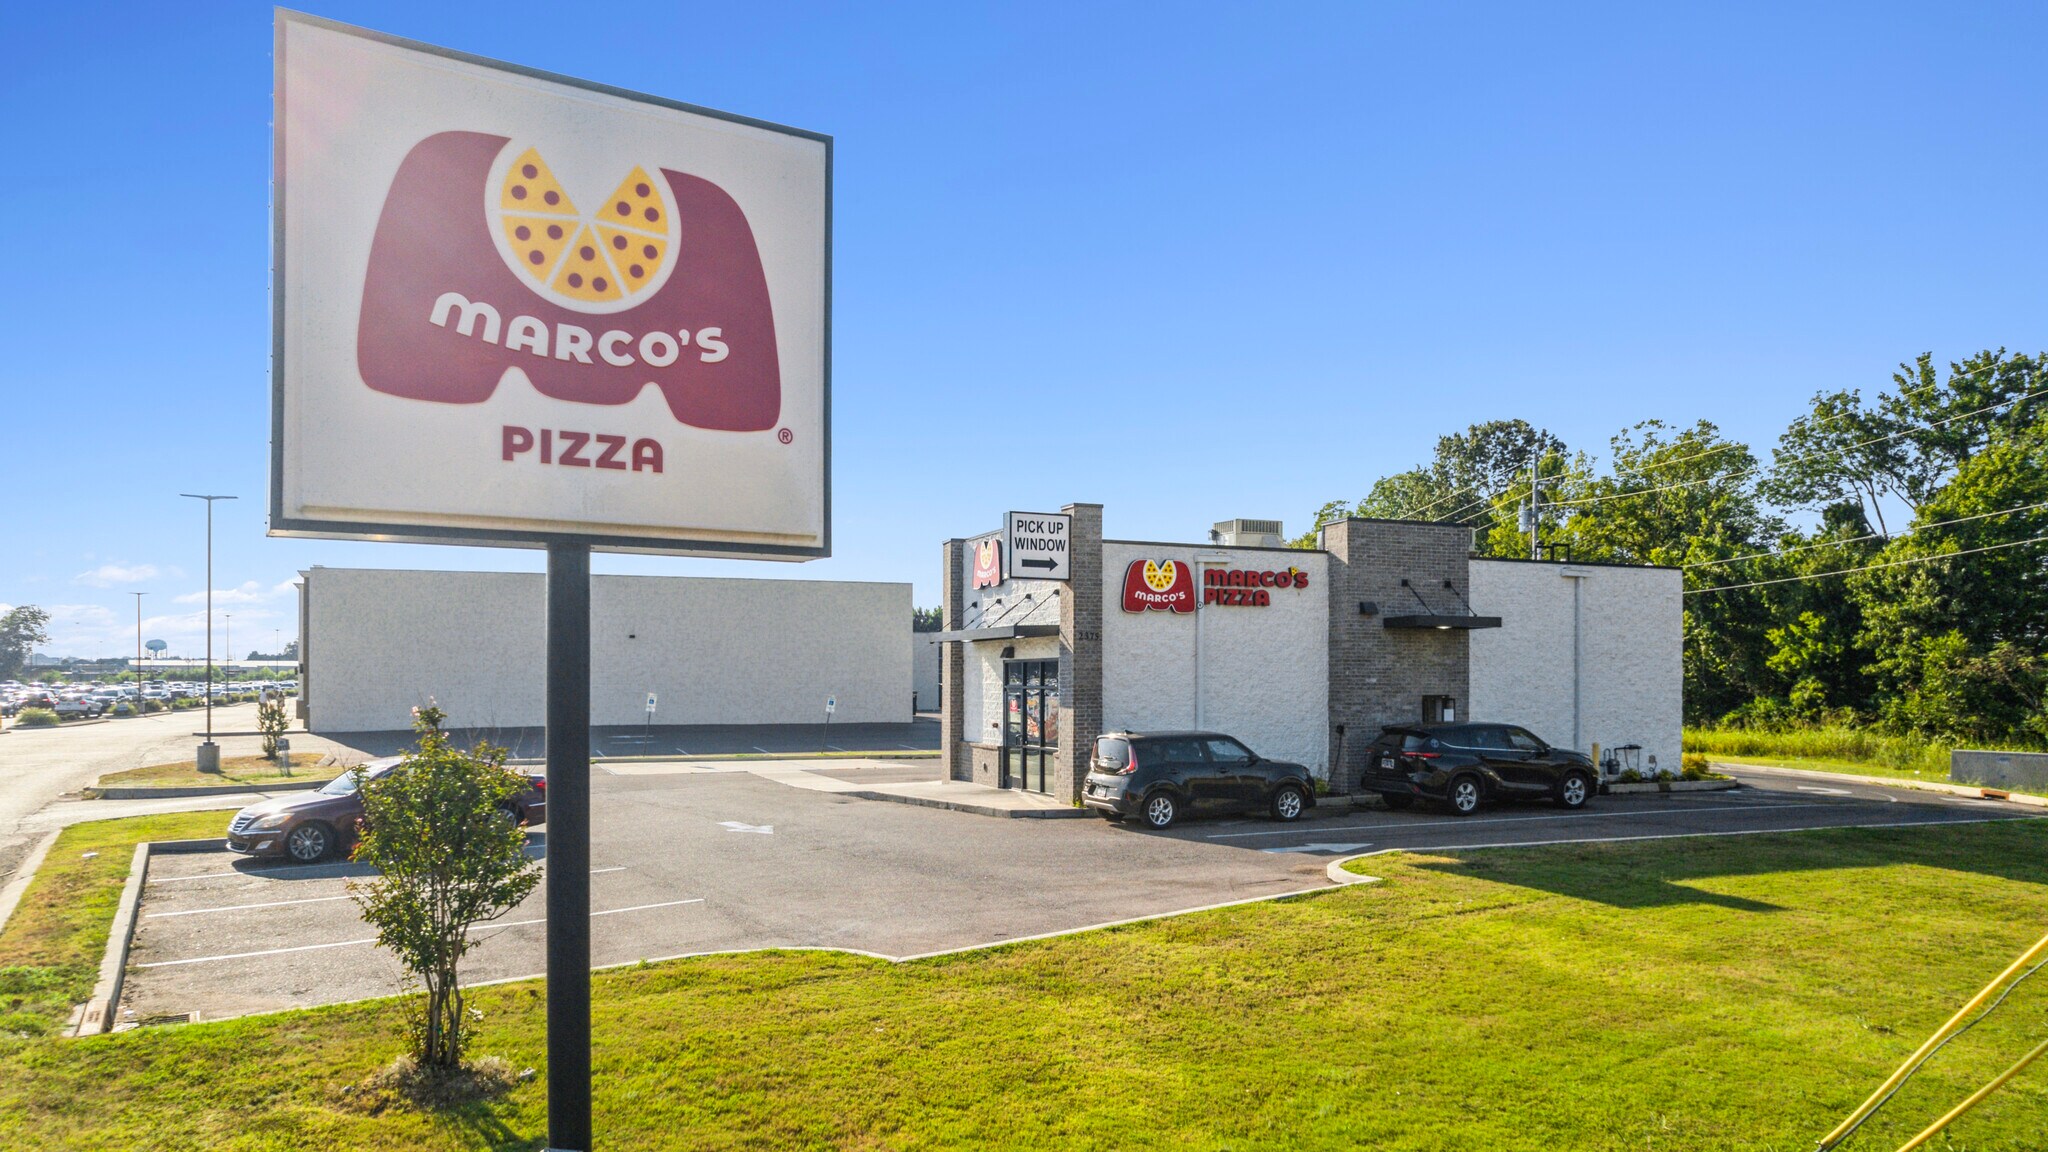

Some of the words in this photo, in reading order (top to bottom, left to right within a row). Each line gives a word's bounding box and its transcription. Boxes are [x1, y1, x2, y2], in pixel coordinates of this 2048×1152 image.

[429, 292, 729, 367] MARCO'S
[502, 425, 664, 474] PIZZA
[1016, 519, 1044, 533] PICK
[1048, 521, 1063, 534] UP
[1014, 537, 1066, 552] WINDOW
[1204, 567, 1309, 588] MARCO'S
[1135, 590, 1186, 603] MARCO'S
[1204, 588, 1270, 607] PIZZA
